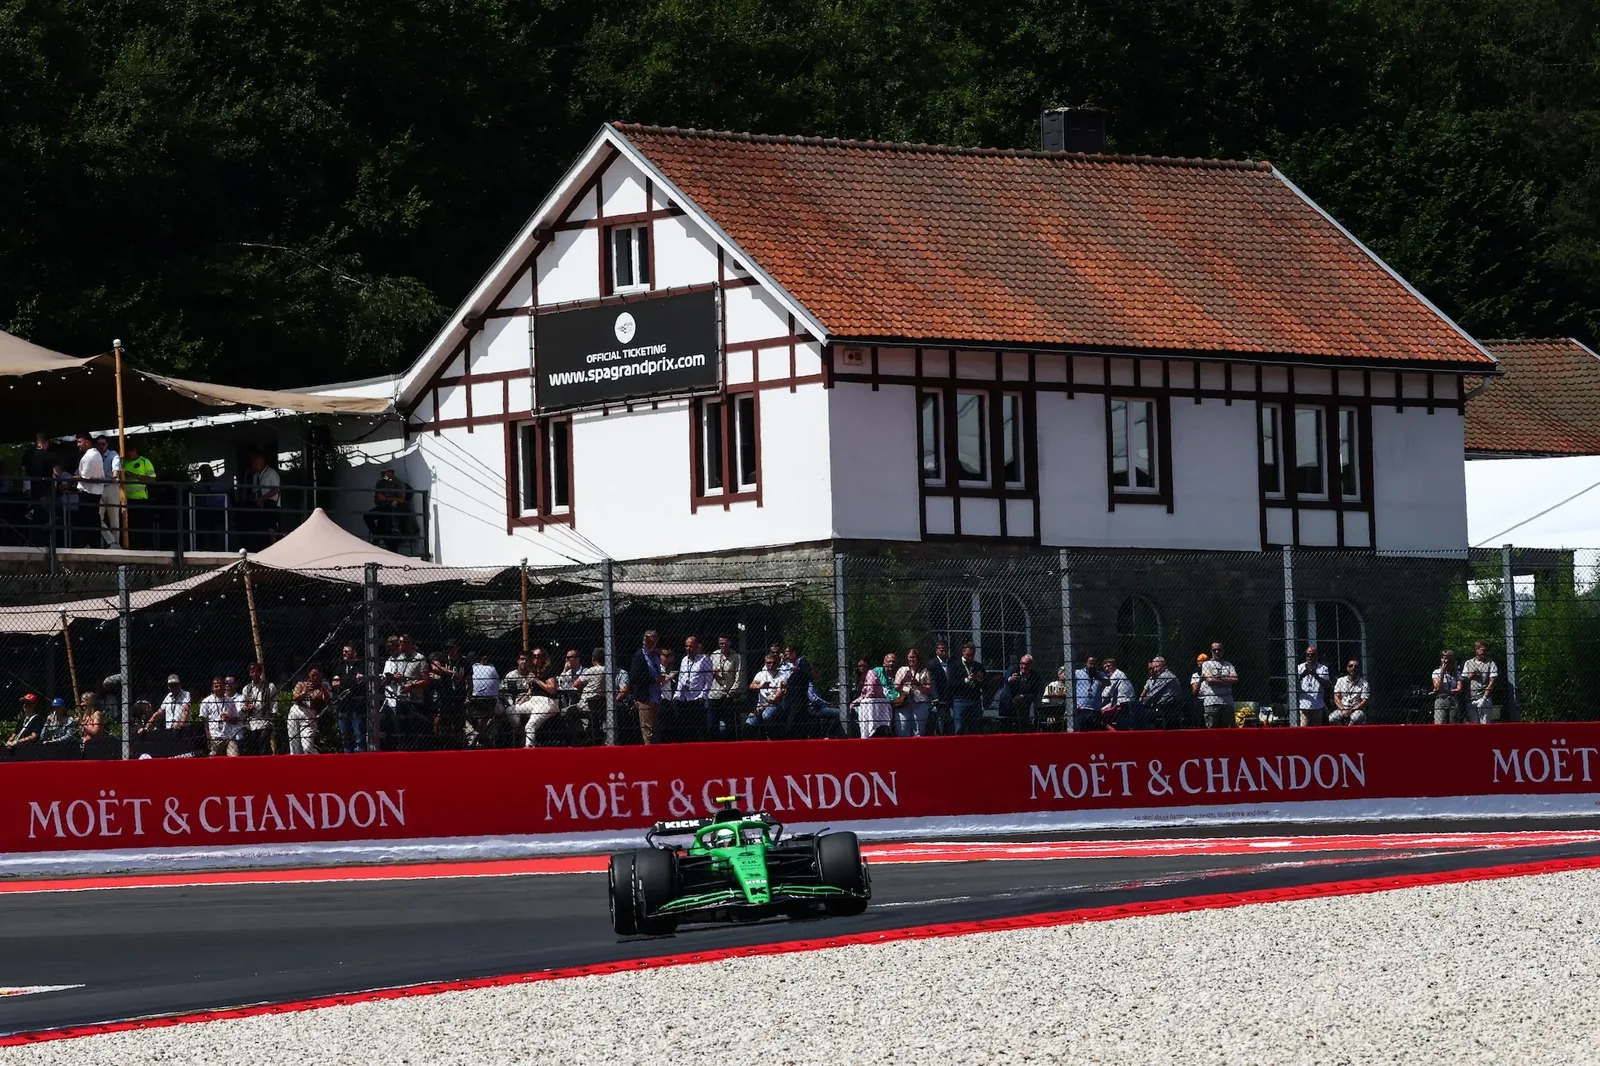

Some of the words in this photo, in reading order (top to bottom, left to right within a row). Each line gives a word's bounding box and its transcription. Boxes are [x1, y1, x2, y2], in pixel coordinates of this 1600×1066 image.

[549, 353, 706, 386] www.spagrandprix.com
[586, 350, 621, 363] OFFICIAL
[622, 344, 667, 358] TICKETING
[1030, 754, 1137, 799] MOËT
[1148, 760, 1173, 795] &
[1179, 753, 1365, 794] CHANDON
[1492, 738, 1598, 783] MOËT
[28, 789, 152, 838] MOËT
[162, 796, 191, 835] &
[198, 789, 406, 833] CHANDON
[545, 772, 658, 820] MOËT
[668, 778, 695, 817] &
[702, 771, 898, 814] CHANDON
[665, 819, 700, 829] KICK
